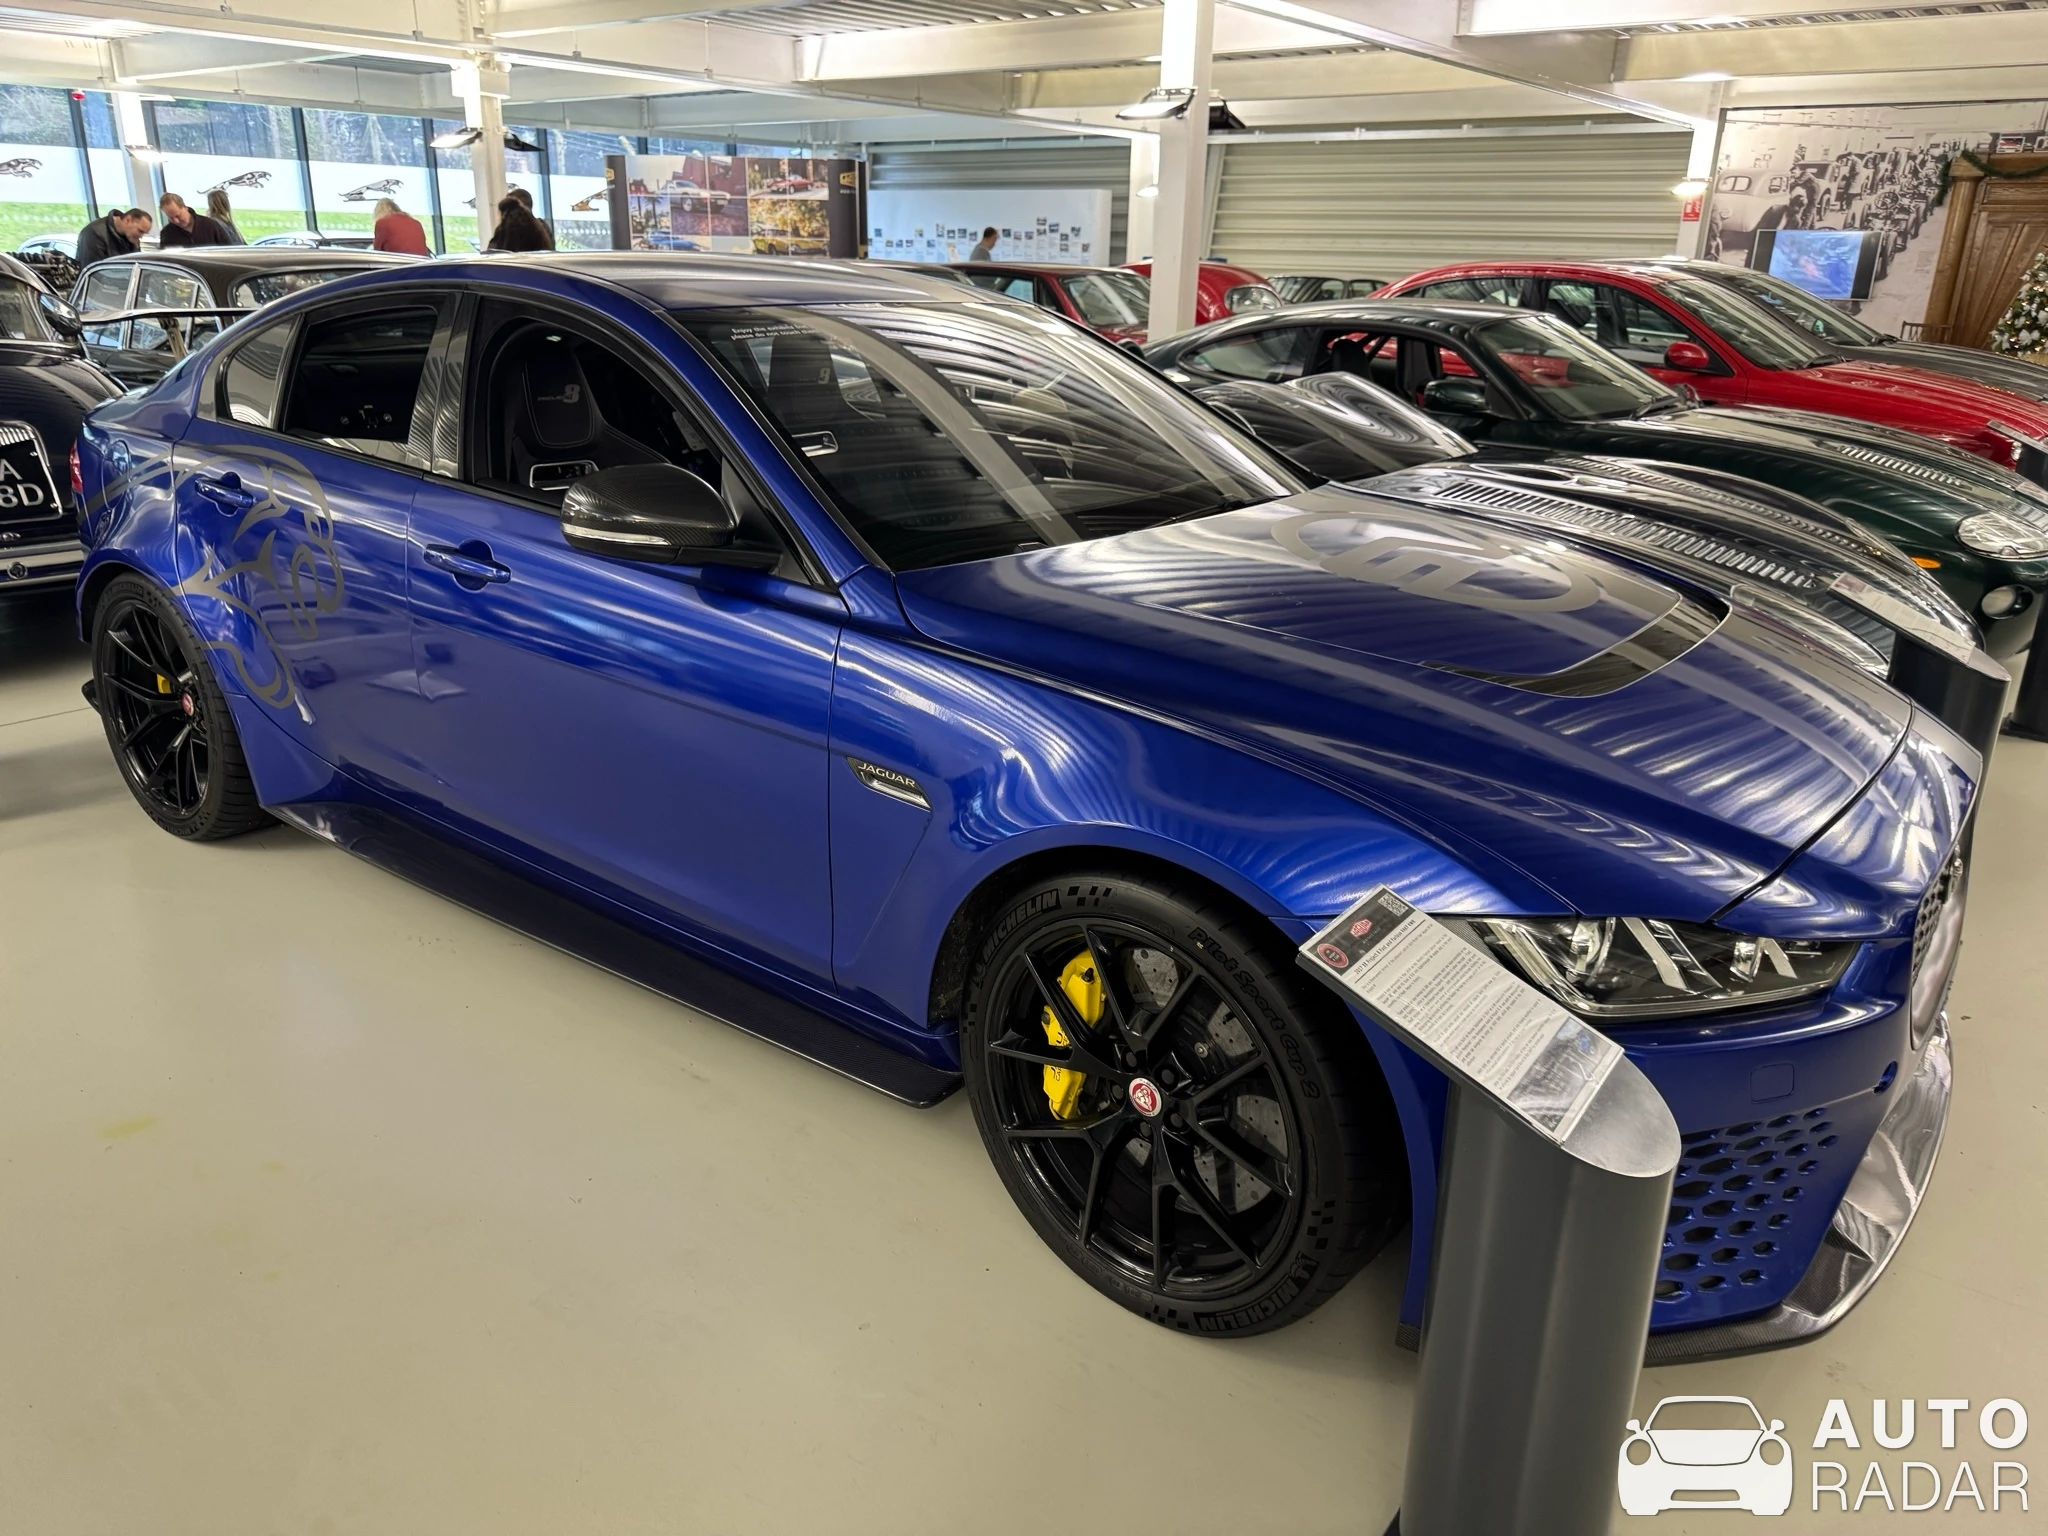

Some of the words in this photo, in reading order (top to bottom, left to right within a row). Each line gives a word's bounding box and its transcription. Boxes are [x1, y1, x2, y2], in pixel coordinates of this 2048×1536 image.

[0, 458, 23, 482] A
[858, 763, 916, 788] JAGUAR
[981, 889, 1063, 964] MICHELIN
[1188, 926, 1240, 971] Pilot
[1233, 969, 1287, 1030] Sport
[1279, 1033, 1308, 1079] Cup
[1300, 1080, 1321, 1099] 2
[1199, 1275, 1301, 1332] MICHELIN
